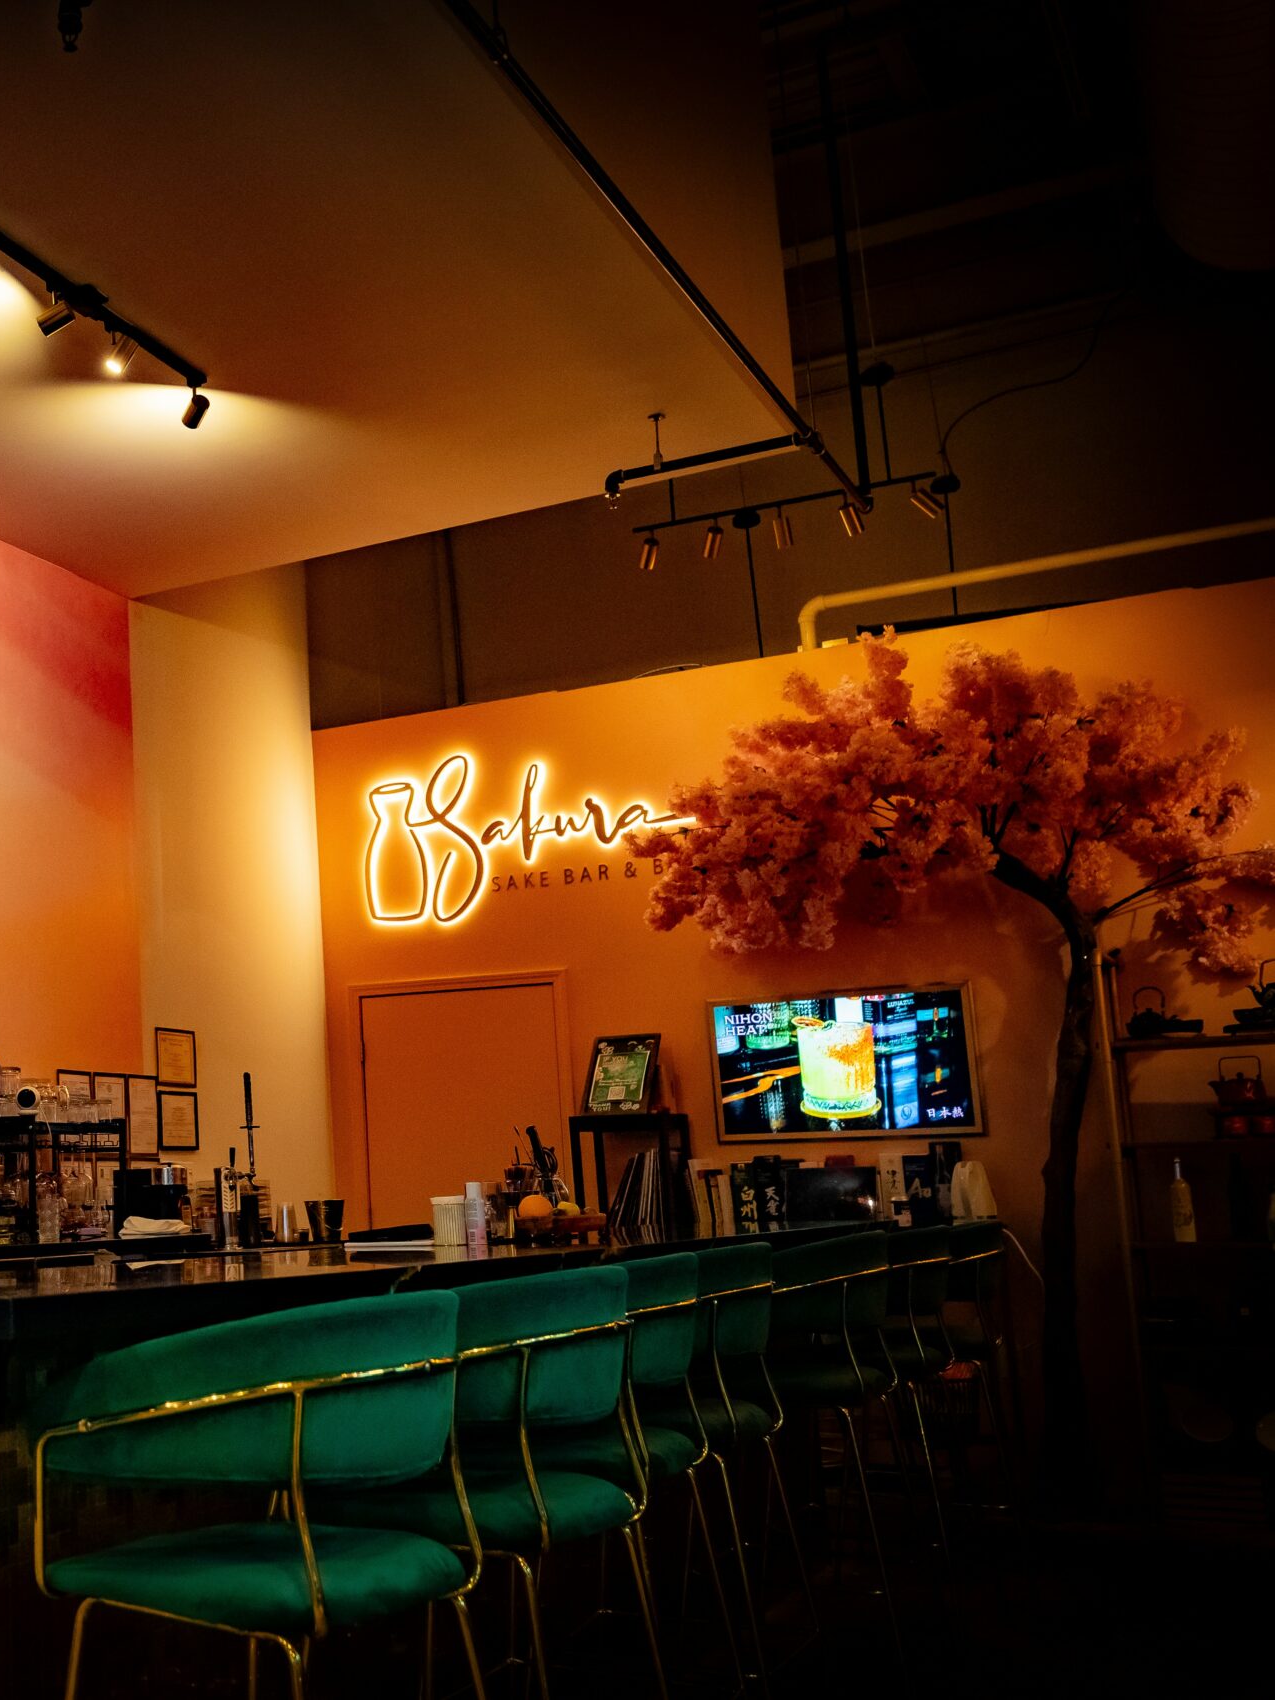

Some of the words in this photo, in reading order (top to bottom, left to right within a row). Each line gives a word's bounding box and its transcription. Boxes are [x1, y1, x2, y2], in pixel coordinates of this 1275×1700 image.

[425, 754, 683, 922] Sakura
[492, 871, 549, 892] SAKE
[564, 864, 609, 885] BAR
[624, 861, 637, 878] &
[724, 1013, 773, 1025] NIHON
[740, 1185, 758, 1221] 白州
